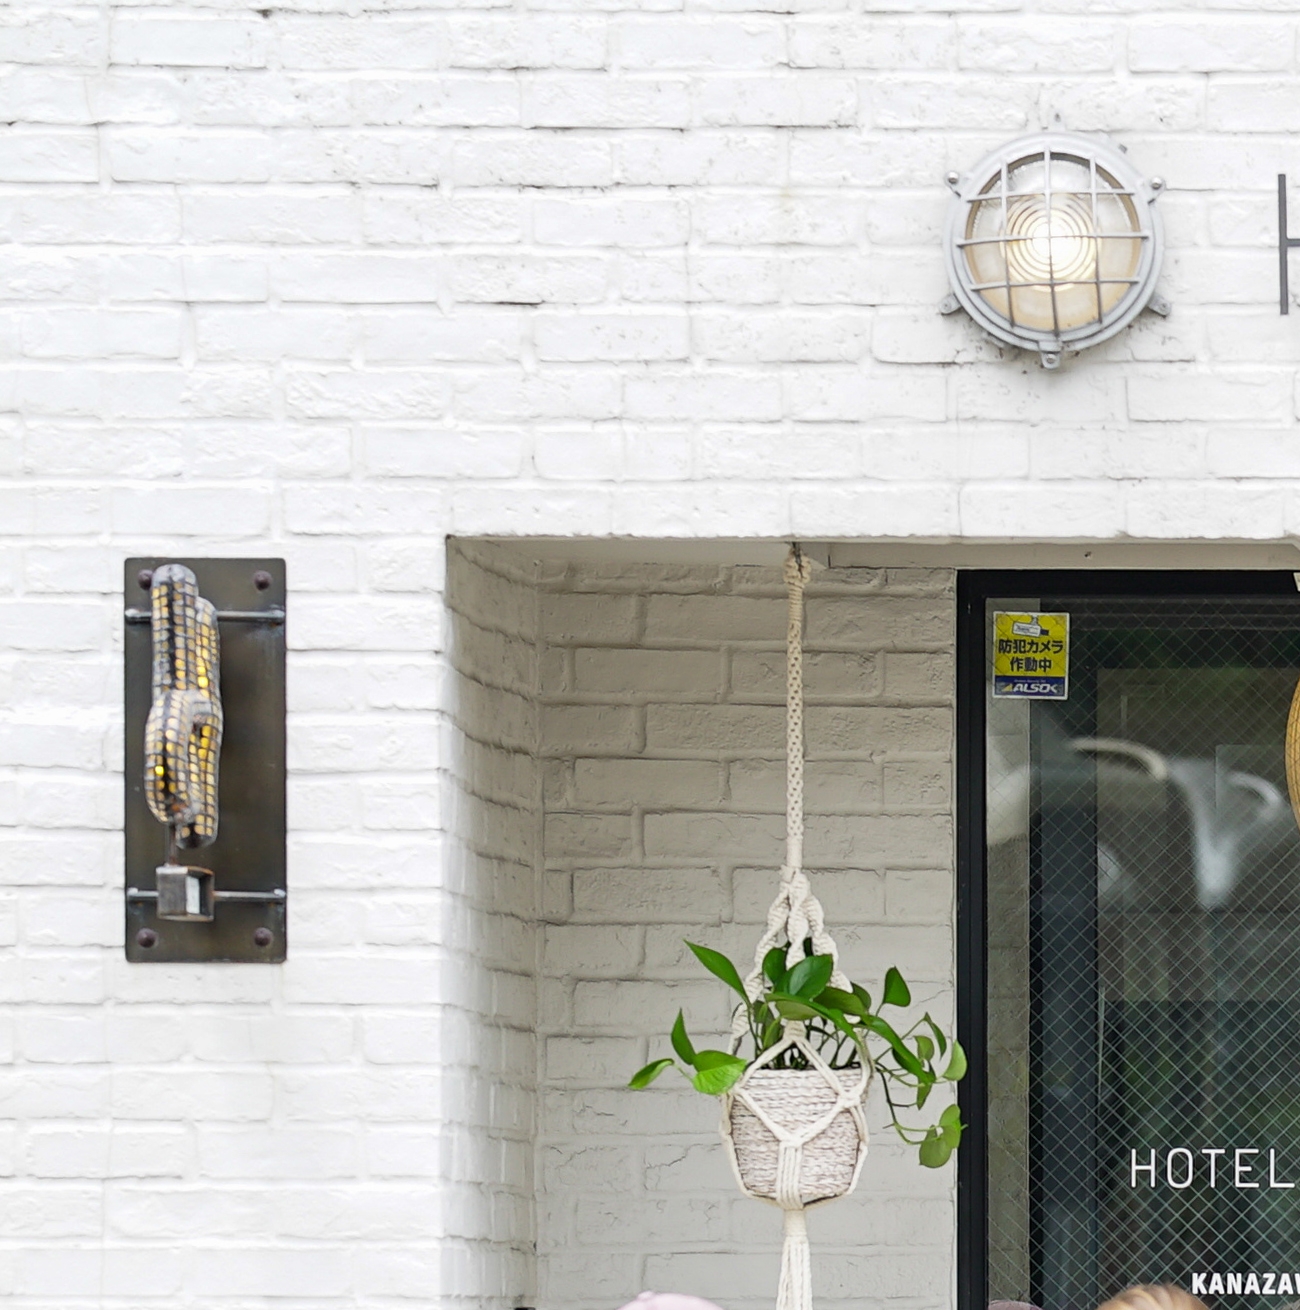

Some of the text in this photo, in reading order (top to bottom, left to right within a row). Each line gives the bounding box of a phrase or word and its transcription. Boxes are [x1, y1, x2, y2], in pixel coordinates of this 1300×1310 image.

[998, 639, 1064, 654] 防犯カメラ
[1010, 657, 1052, 672] 作動中
[1013, 683, 1057, 693] ALSOK
[1130, 1148, 1296, 1189] HOTEL
